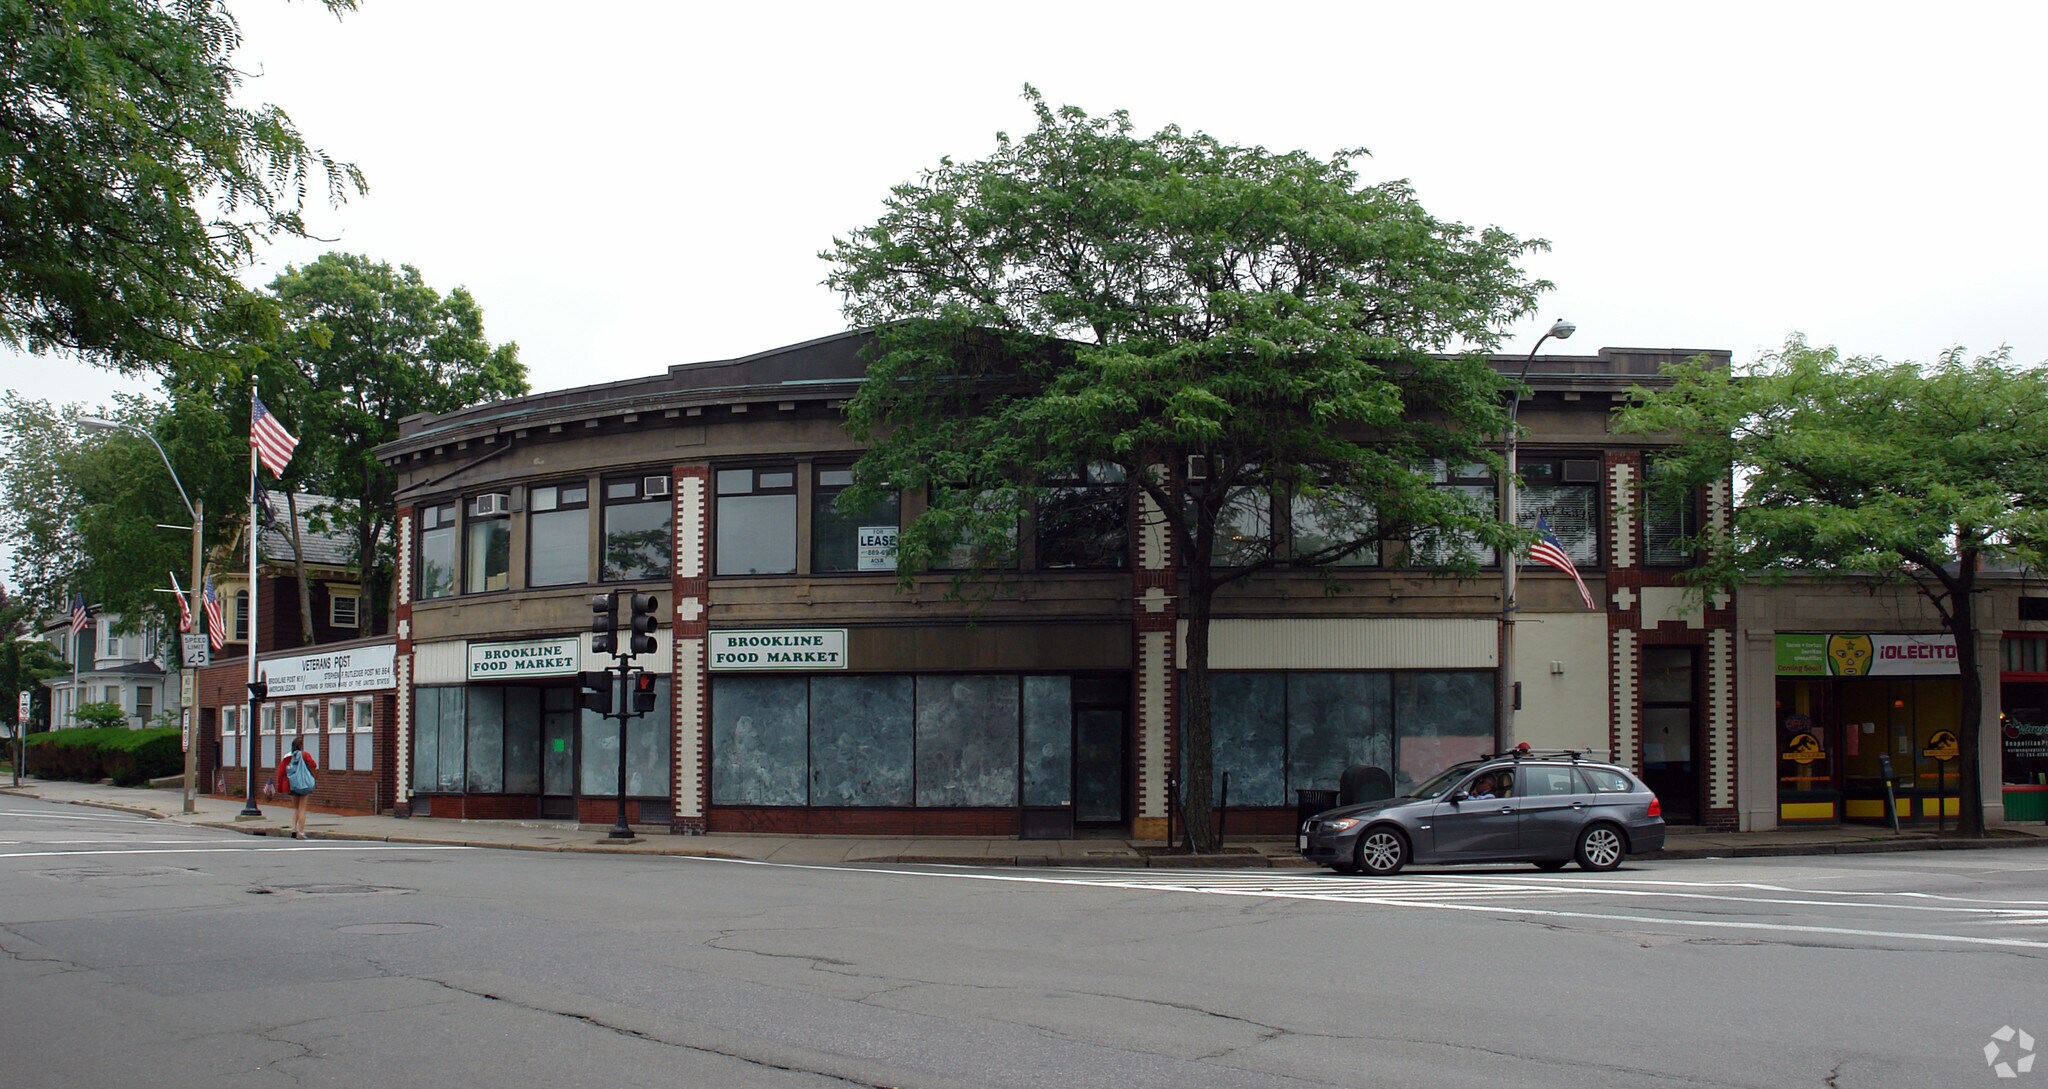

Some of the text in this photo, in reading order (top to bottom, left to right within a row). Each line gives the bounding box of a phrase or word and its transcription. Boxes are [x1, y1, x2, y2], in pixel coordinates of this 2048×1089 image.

[861, 535, 896, 546] LEASE
[728, 636, 824, 647] BROOKLINE
[188, 651, 205, 663] 25
[485, 646, 562, 659] BROOKLINE
[717, 652, 838, 663] FOOD MARKET
[302, 655, 350, 671] VETERANS POST
[474, 657, 573, 671] FOOD MARKET
